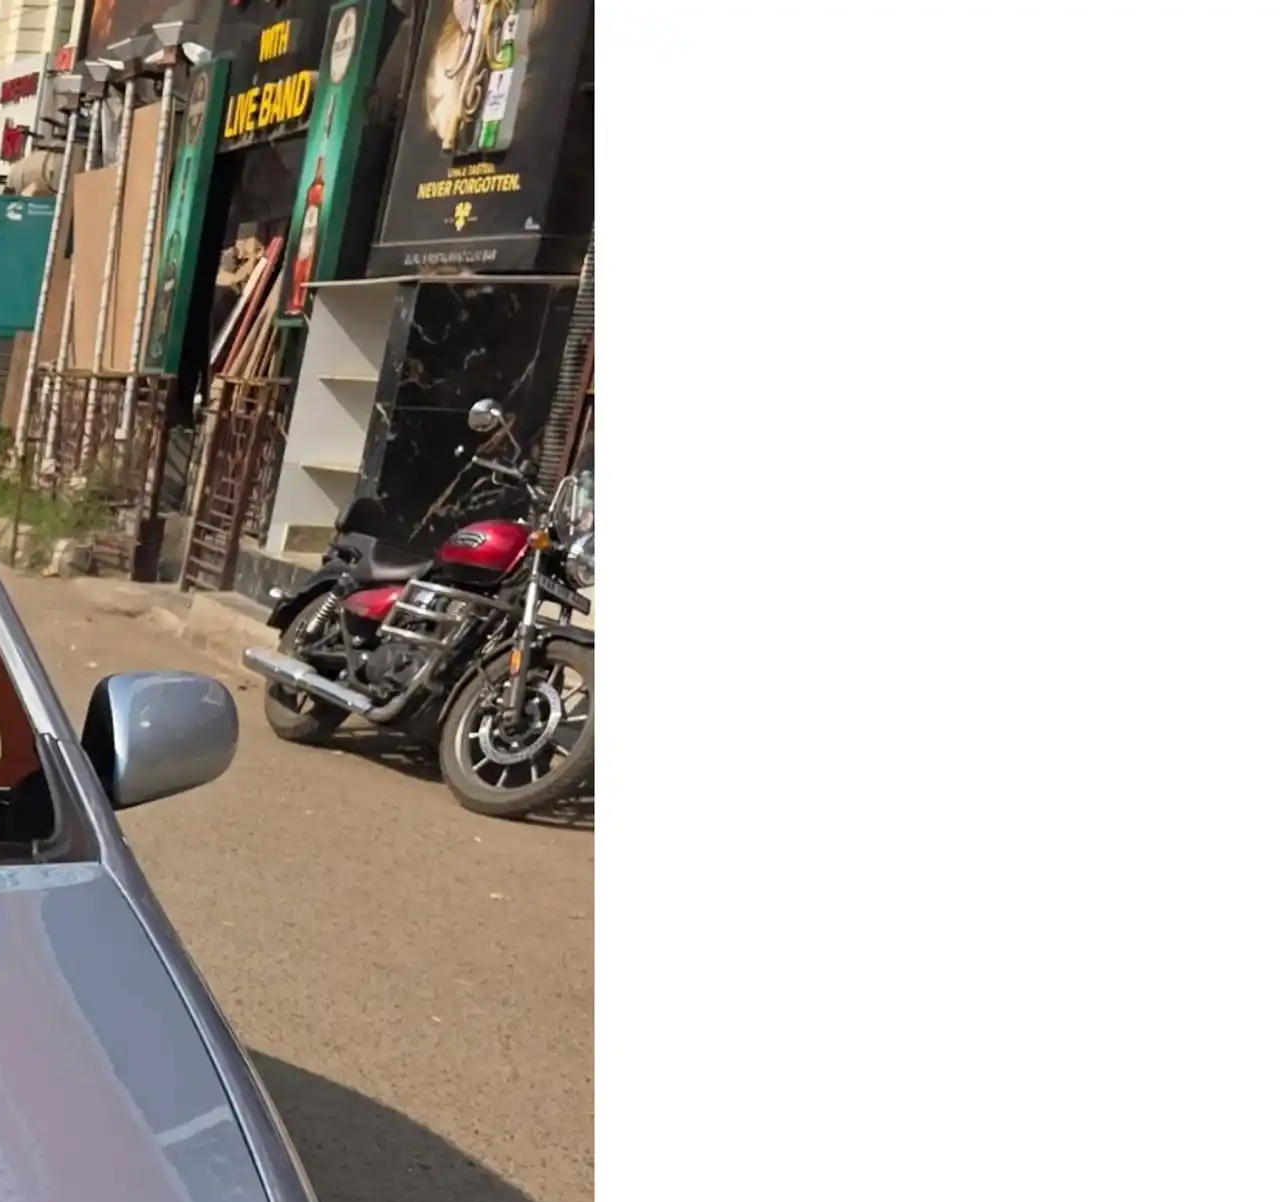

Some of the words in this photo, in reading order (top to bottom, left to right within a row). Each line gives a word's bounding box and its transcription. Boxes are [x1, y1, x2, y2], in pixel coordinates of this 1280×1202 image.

[259, 20, 291, 62] WITH
[224, 87, 260, 138] LIVE
[257, 70, 313, 127] BAND
[416, 178, 453, 200] NEVER
[452, 172, 522, 197] FORGOTTEN.
